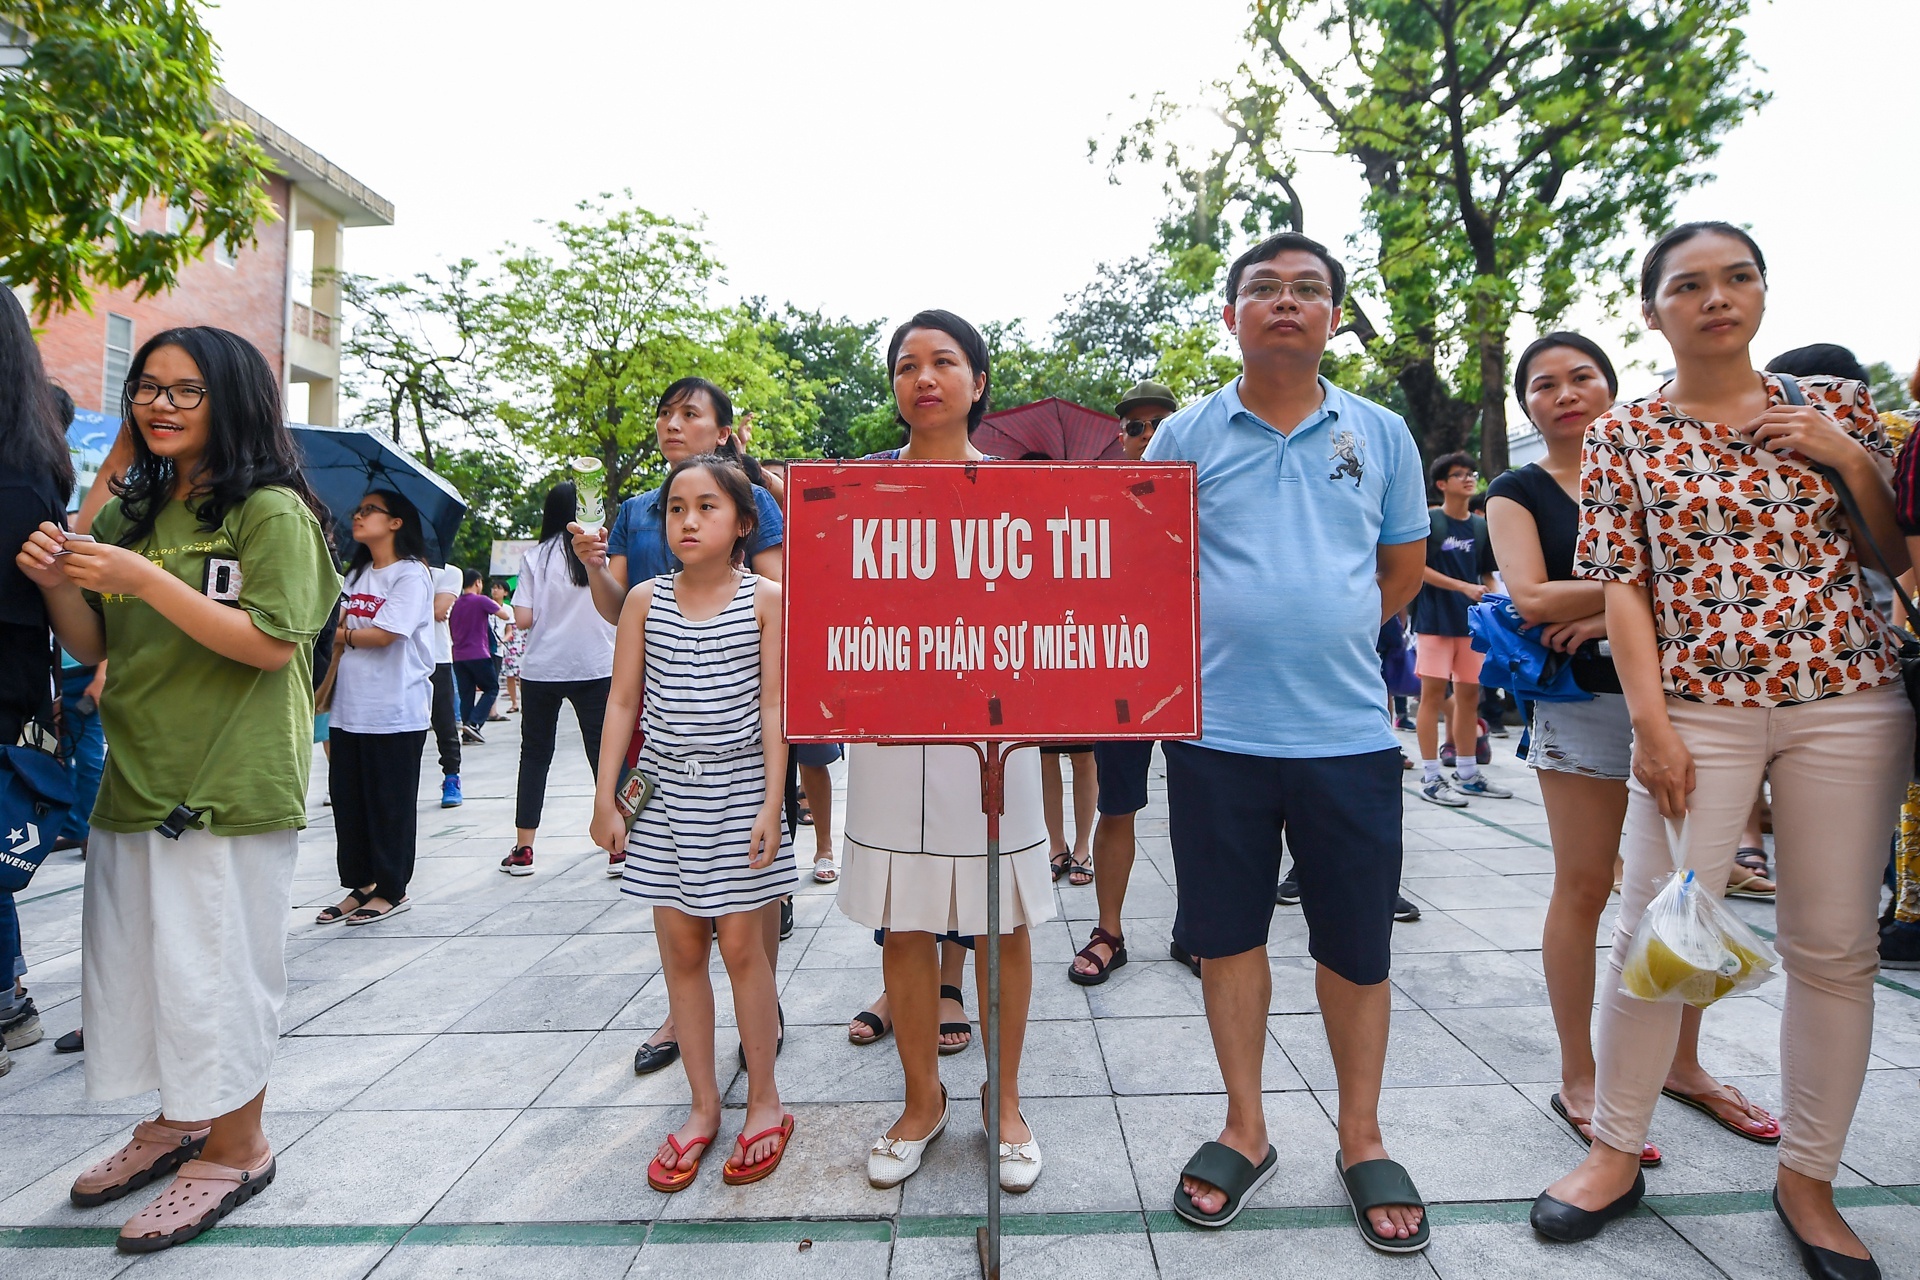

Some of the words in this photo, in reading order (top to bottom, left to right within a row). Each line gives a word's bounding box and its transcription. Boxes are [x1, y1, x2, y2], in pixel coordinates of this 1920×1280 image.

[852, 518, 937, 580] KHU
[950, 512, 1033, 592] VỰC
[1046, 518, 1111, 579] THI
[827, 616, 911, 672] KHÔNG
[919, 616, 985, 680] PHẬN
[993, 620, 1028, 680] SỰ
[1033, 610, 1096, 670] MIỄN
[1102, 615, 1150, 670] VÀO
